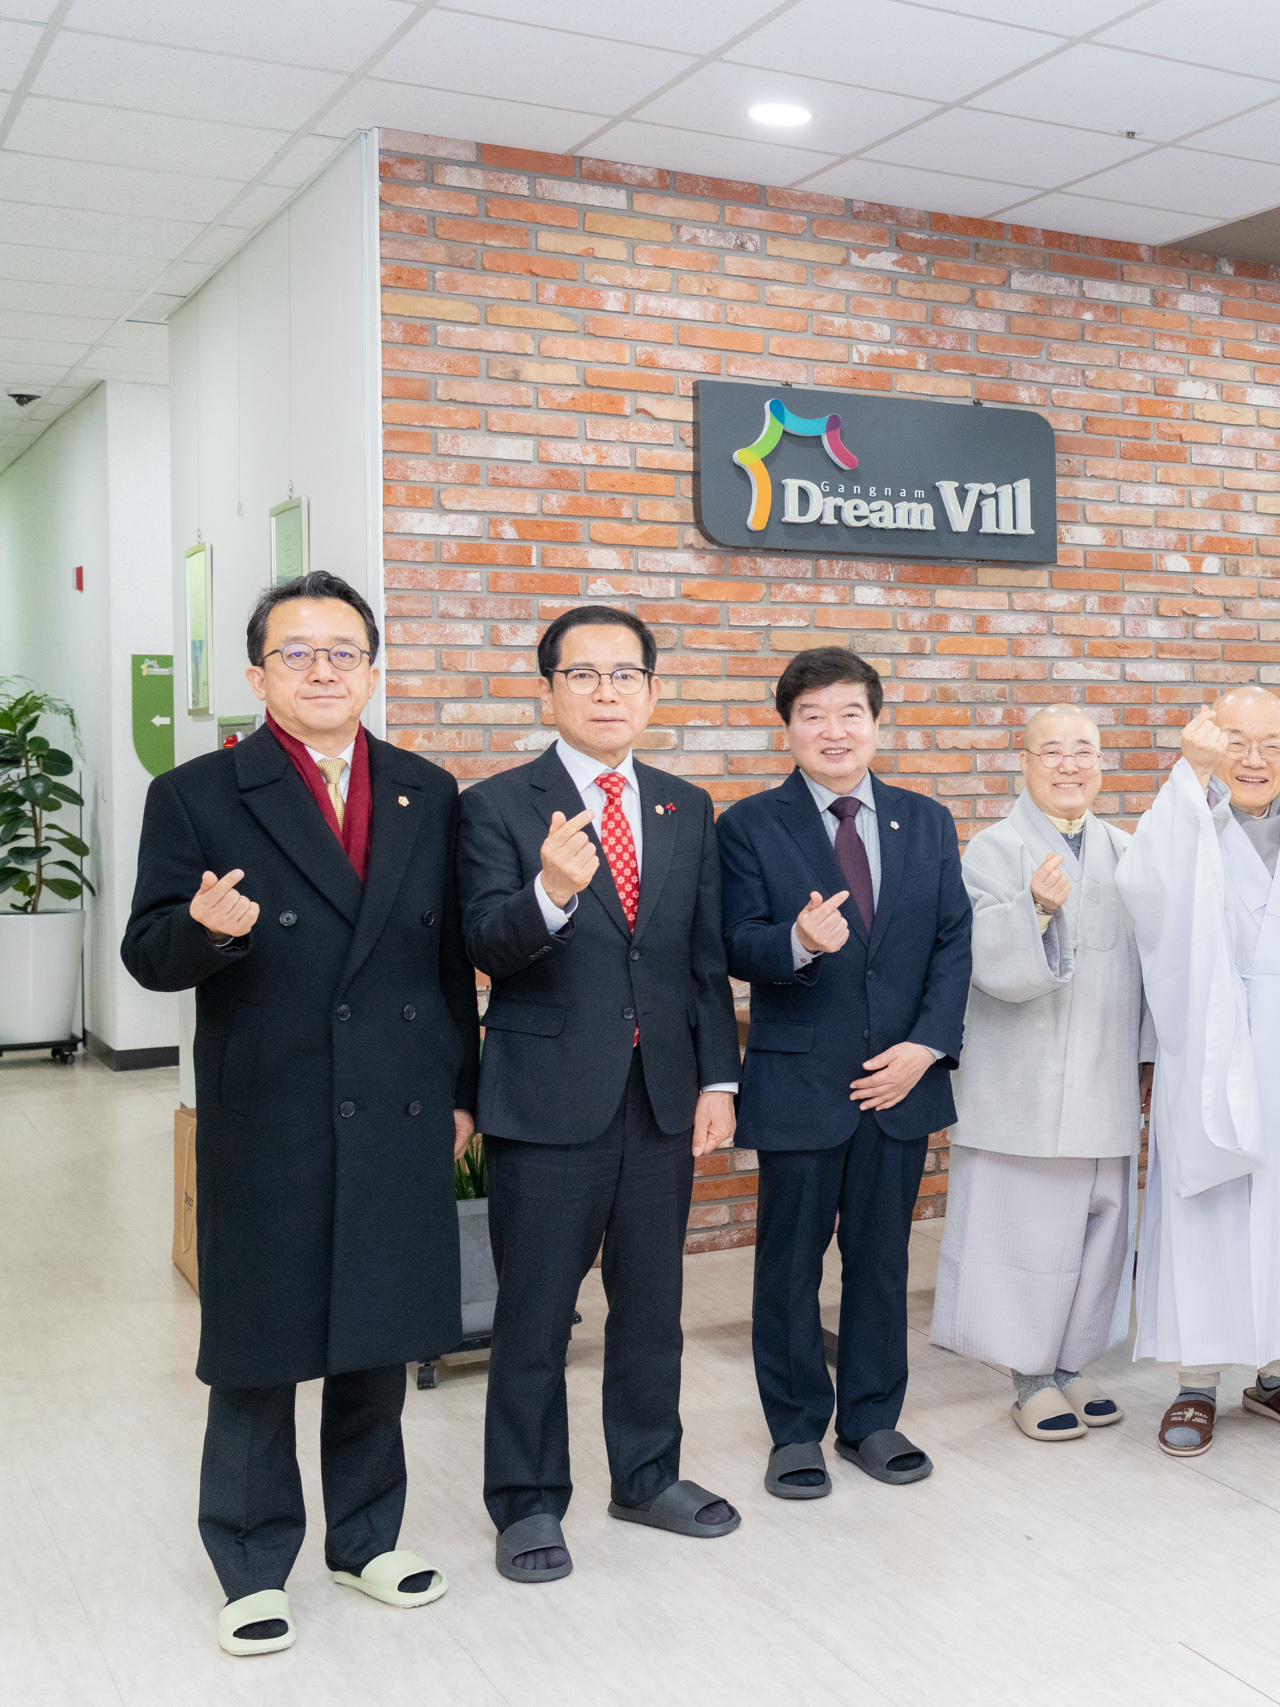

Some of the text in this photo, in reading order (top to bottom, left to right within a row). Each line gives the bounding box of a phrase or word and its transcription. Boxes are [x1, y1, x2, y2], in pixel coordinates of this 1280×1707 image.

[781, 478, 1035, 535] Dream Vill
[820, 480, 925, 498] Gangnam
